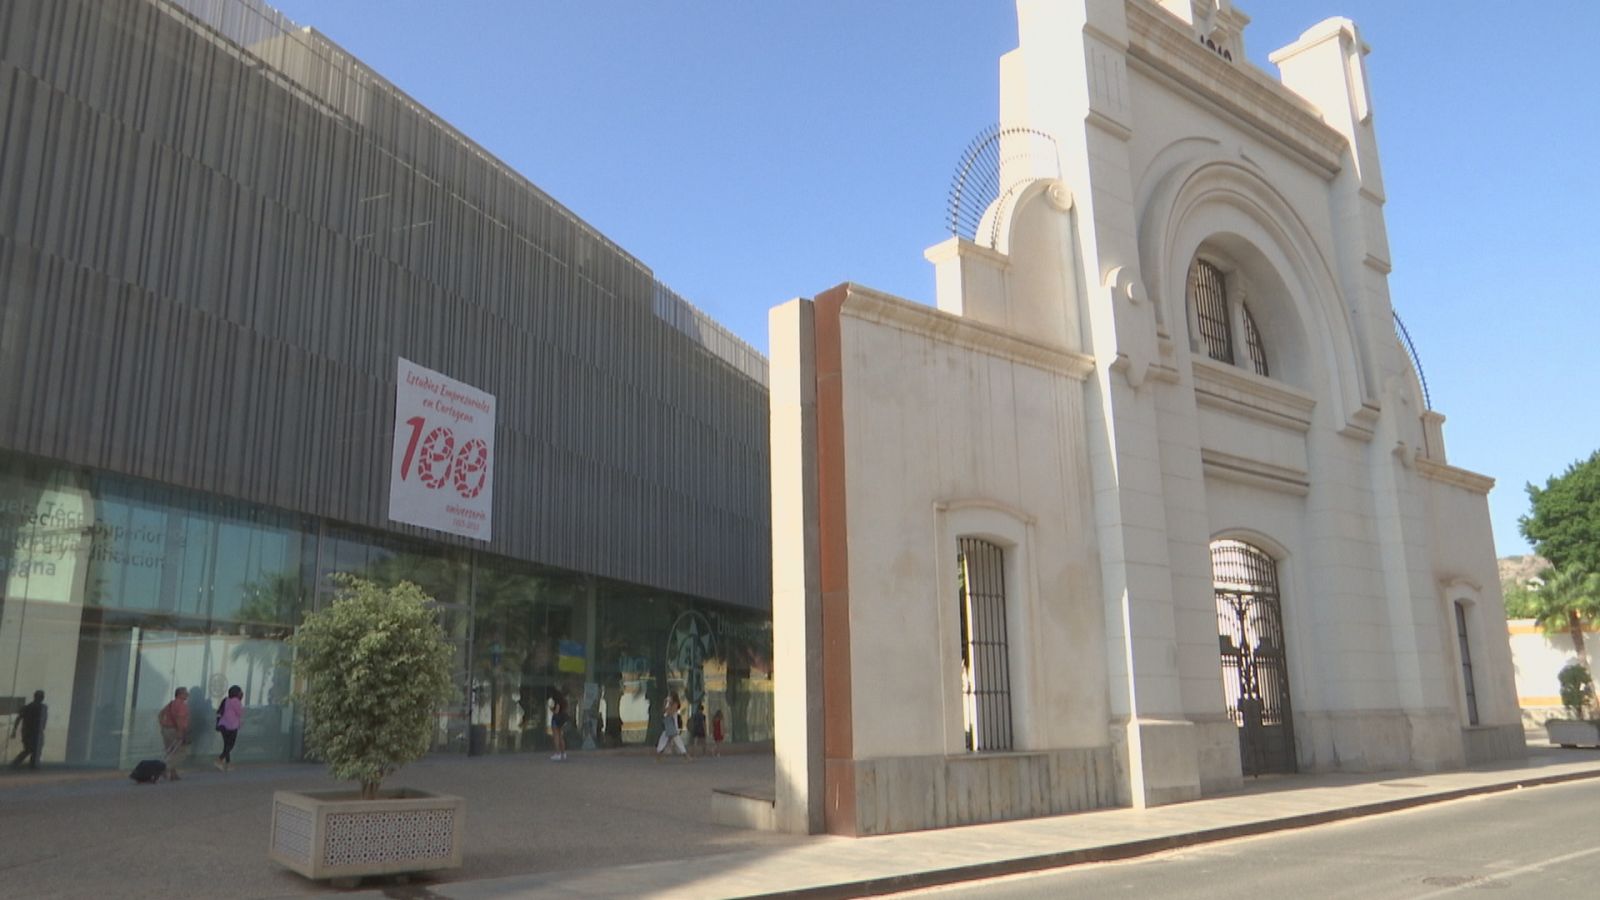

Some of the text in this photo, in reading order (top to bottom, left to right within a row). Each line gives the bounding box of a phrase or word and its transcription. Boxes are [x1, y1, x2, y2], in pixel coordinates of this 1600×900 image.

[423, 398, 474, 424] en Cartagena
[440, 385, 490, 413] Empresariales
[401, 416, 488, 498] 100
